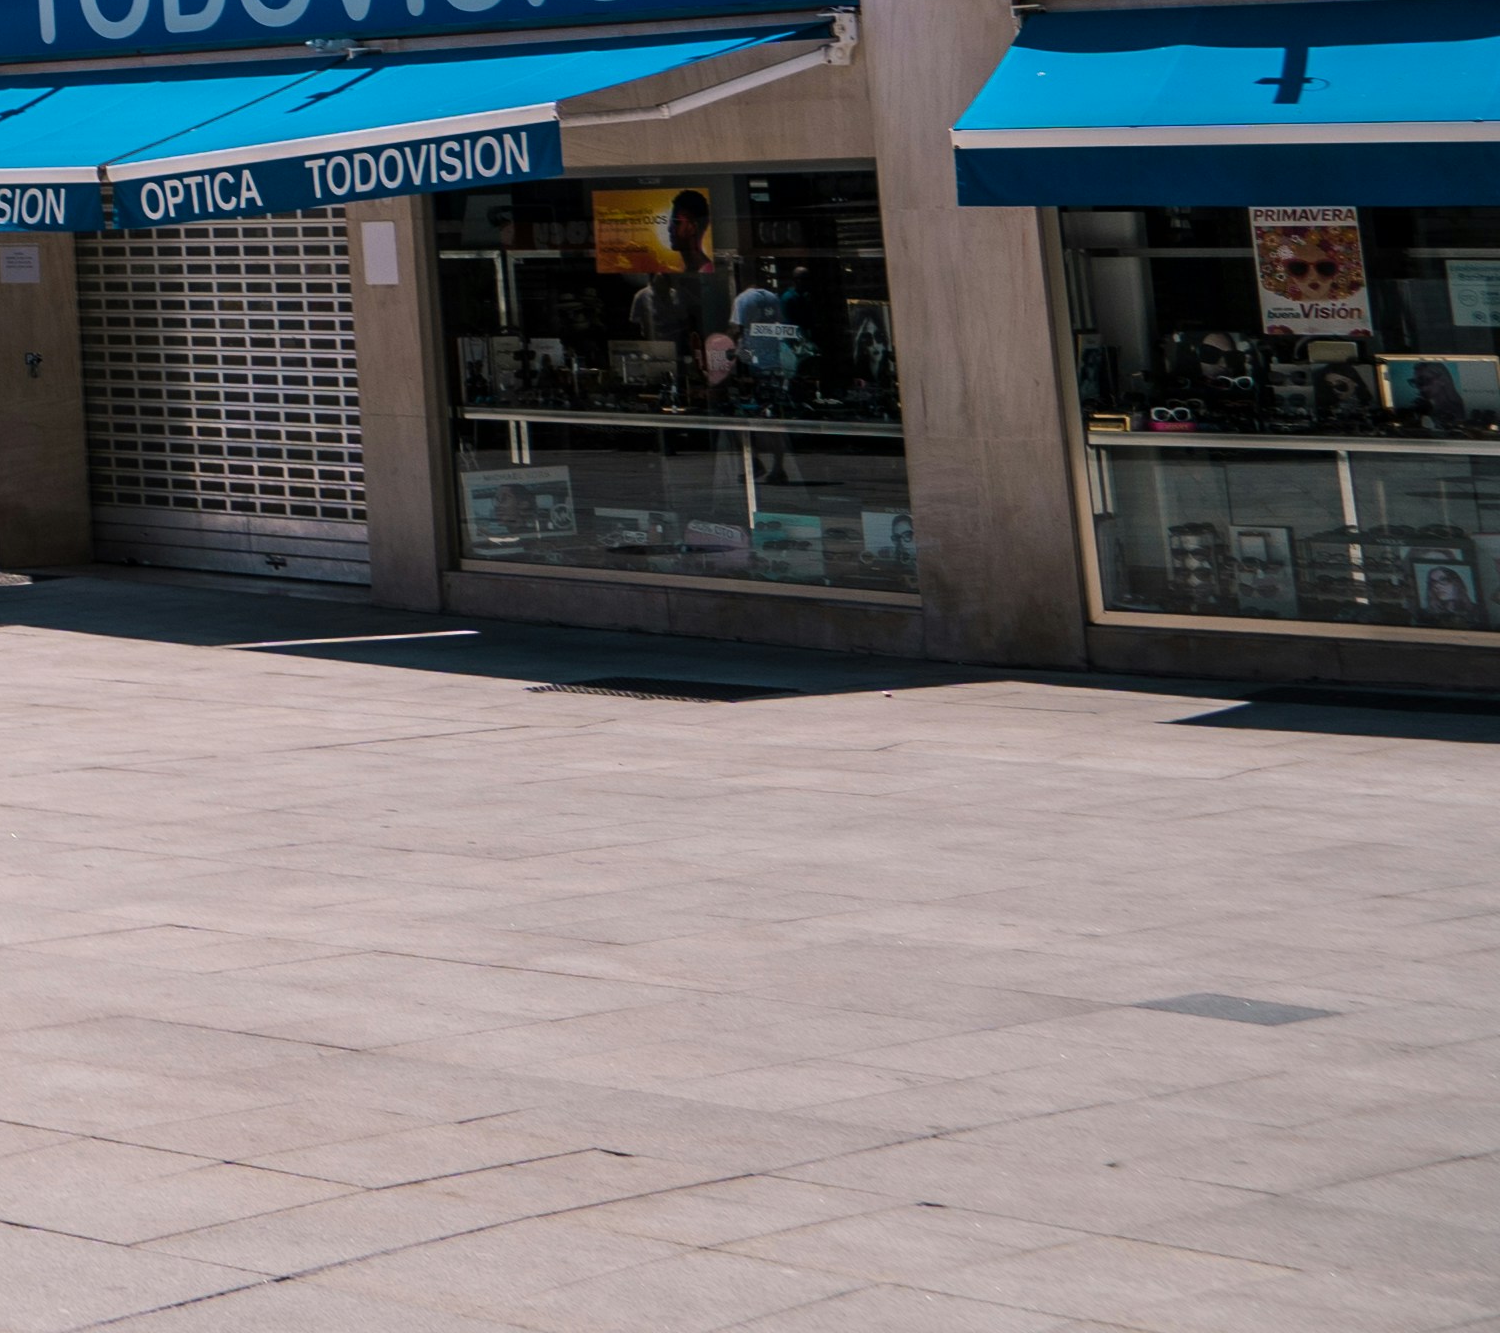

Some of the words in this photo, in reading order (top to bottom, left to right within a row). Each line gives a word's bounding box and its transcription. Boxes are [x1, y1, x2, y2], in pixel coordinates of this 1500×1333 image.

[140, 169, 263, 221] OPTICA
[305, 132, 530, 200] TODOVISION
[1253, 209, 1356, 222] PRIMAVERA
[1267, 310, 1301, 320] buena
[1300, 302, 1363, 320] Visión
